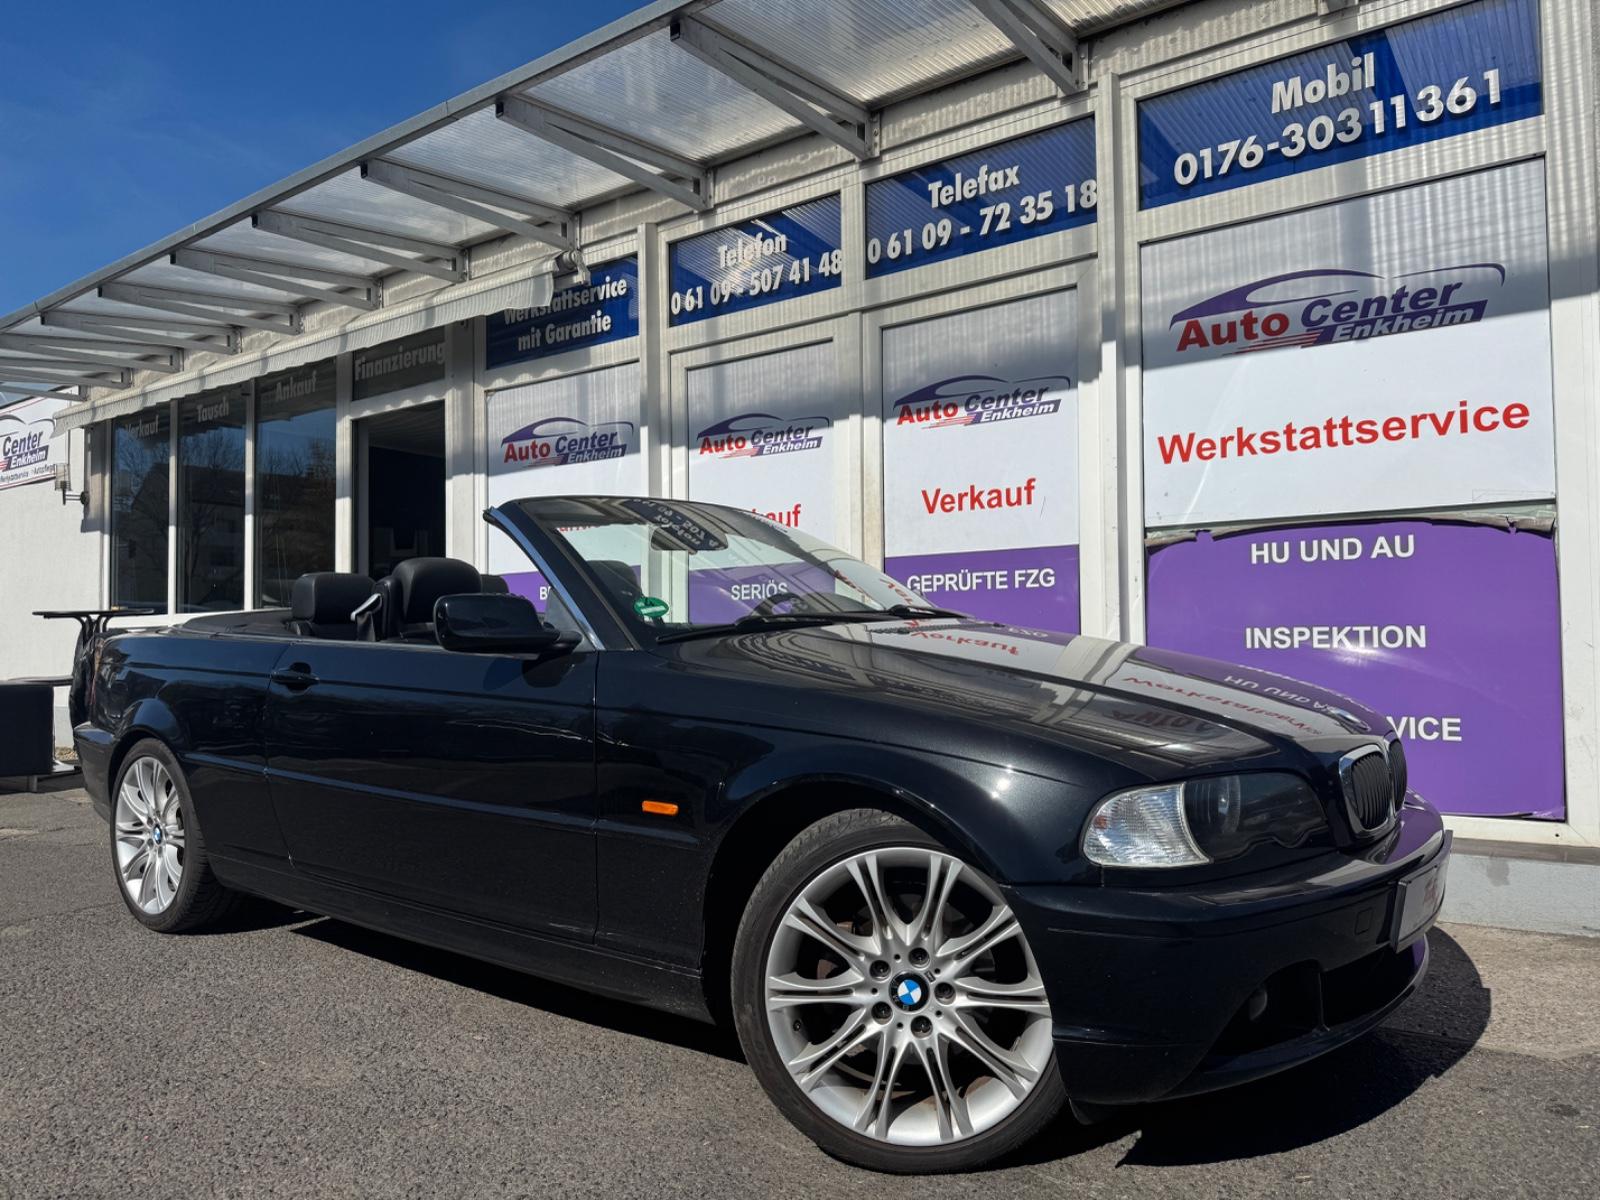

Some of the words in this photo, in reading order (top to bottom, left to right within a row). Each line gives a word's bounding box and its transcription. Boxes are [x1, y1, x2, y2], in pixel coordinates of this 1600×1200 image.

[1271, 53, 1375, 114] Mobil
[928, 165, 1020, 208] Telefax
[922, 218, 952, 250] 09
[979, 202, 1011, 236] 72
[1020, 190, 1053, 224] 35
[1065, 179, 1097, 213] 18
[718, 232, 787, 268] Telefon
[750, 264, 784, 296] 507
[789, 257, 810, 284] 41
[819, 249, 842, 277] 48
[518, 327, 542, 351] mit
[545, 310, 611, 345] Garantie
[1176, 310, 1290, 352] Auto
[1301, 282, 1463, 329] Center
[1331, 307, 1474, 342] Enkheim
[355, 342, 446, 380] Finanzierung
[276, 370, 317, 400] Ankauf
[197, 397, 229, 423] Tausch
[897, 400, 959, 425] Auto
[964, 386, 1050, 413] Center
[980, 402, 1056, 422] Enkheim
[3, 431, 43, 457] Center
[504, 440, 550, 463] Auto
[555, 431, 617, 454] Center
[700, 433, 746, 455] Auto
[751, 425, 814, 446] Center
[763, 439, 818, 455] Enkheim
[1157, 400, 1531, 464] Werkstattservice
[567, 446, 622, 463] Enkheim
[921, 477, 1036, 514] Verkauf
[1250, 541, 1290, 564] HU
[1300, 536, 1363, 562] UND
[1371, 534, 1415, 559] AU
[731, 580, 788, 600] SERIÖS
[907, 568, 1008, 593] GEPRÜFTE
[1014, 567, 1055, 588] FZG
[1245, 625, 1427, 649] INSPEKTION
